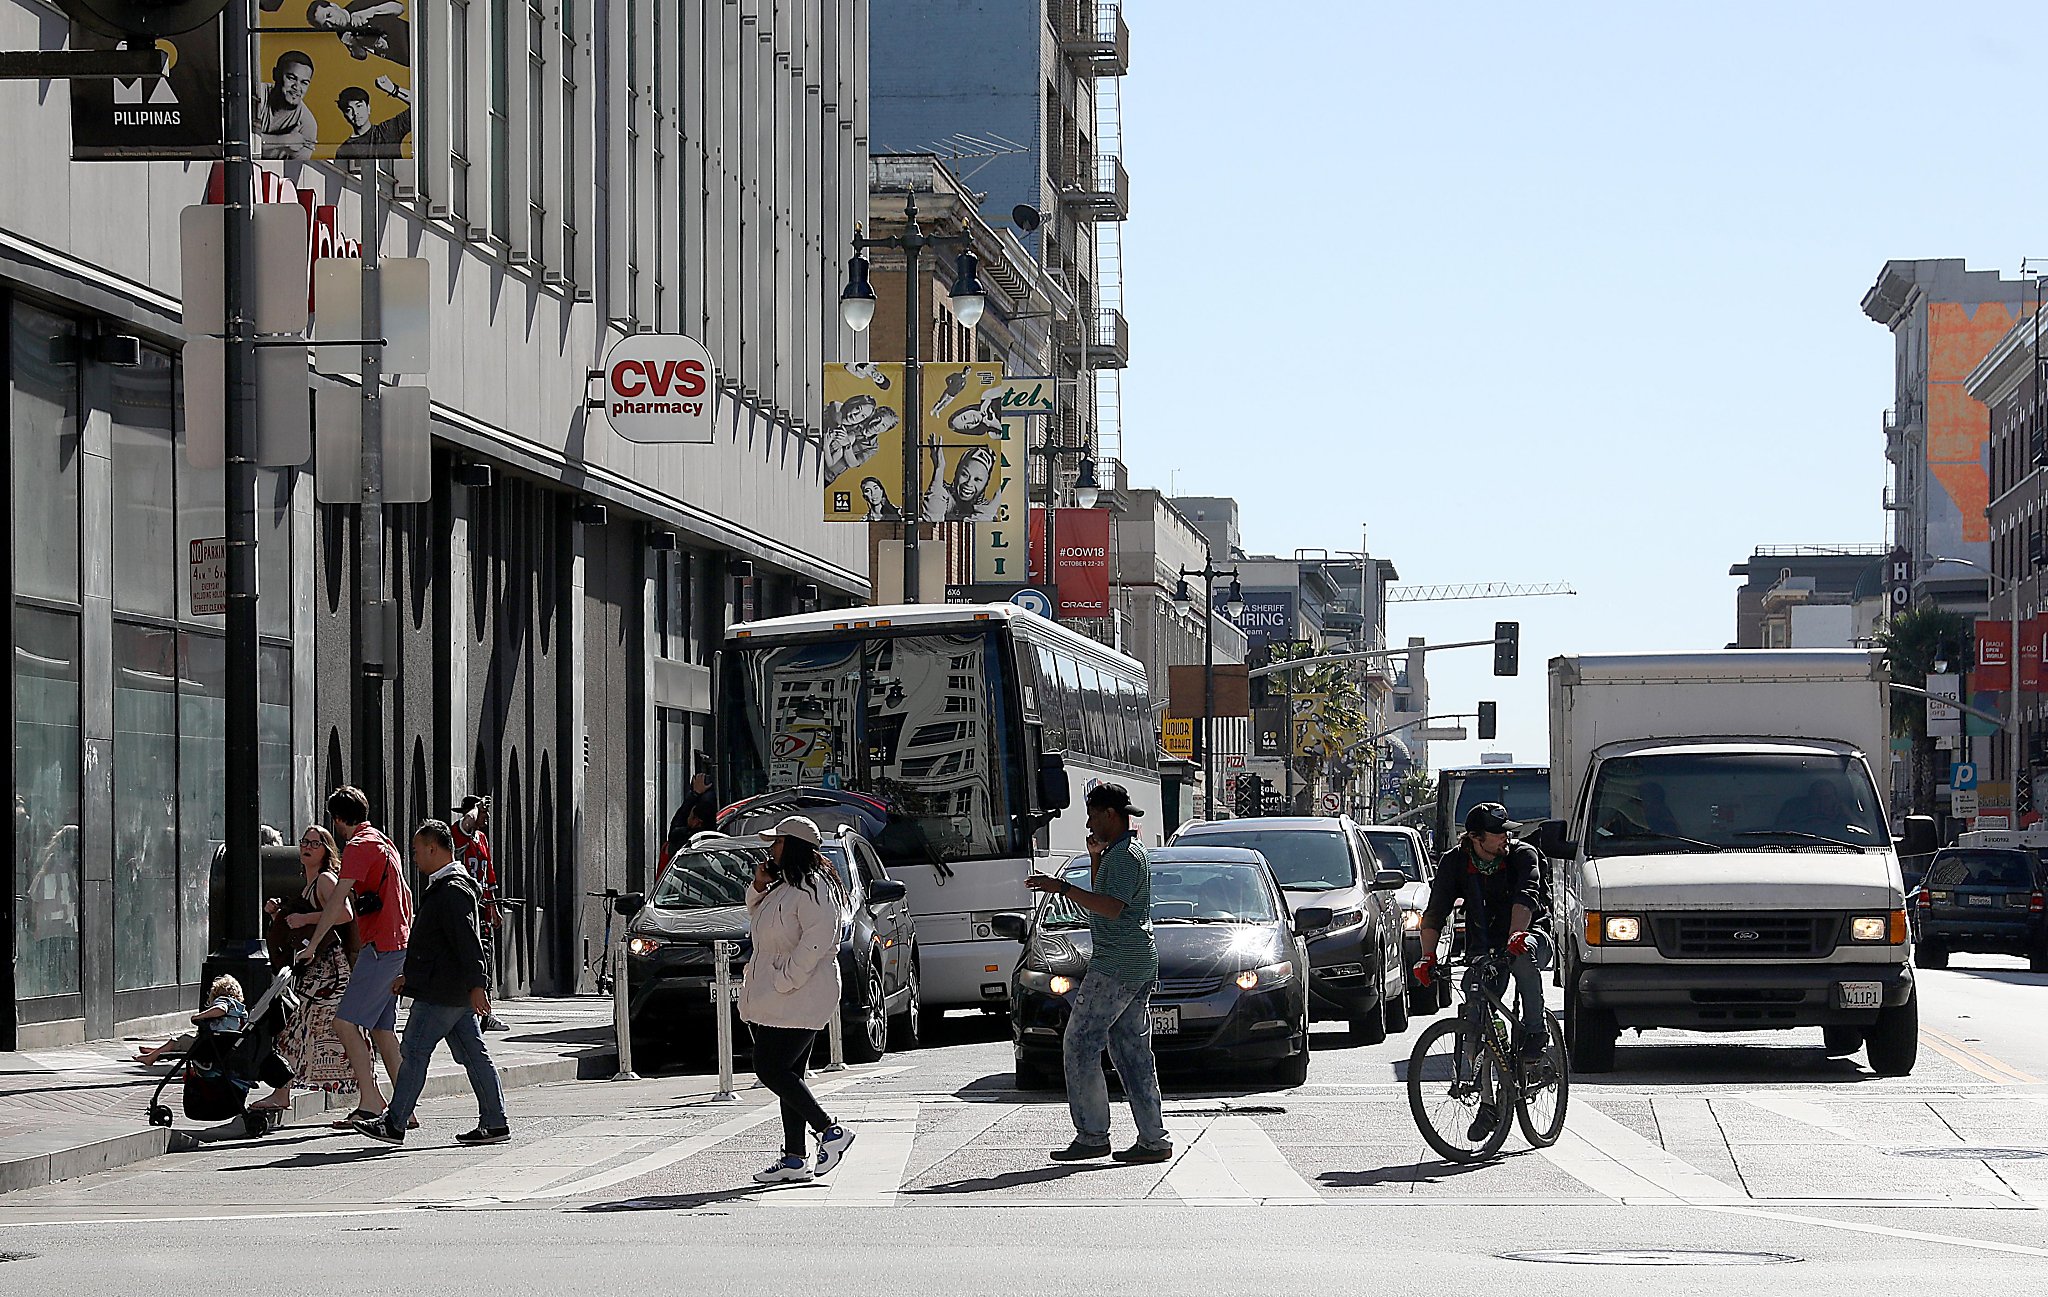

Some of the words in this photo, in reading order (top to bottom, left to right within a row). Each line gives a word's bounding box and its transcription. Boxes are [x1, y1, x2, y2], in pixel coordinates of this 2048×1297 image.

[114, 111, 181, 125] PILIPINAS
[611, 360, 706, 397] CVS
[1001, 383, 1040, 407] tel
[612, 400, 703, 418] pharmacy
[192, 543, 202, 563] NO
[204, 545, 225, 560] PARKIN
[1059, 547, 1105, 557] #OOW18
[947, 588, 961, 596] 6X6
[1061, 601, 1103, 609] ORACLE
[1251, 604, 1285, 612] SHERIFF
[1242, 627, 1263, 635] Team
[1165, 722, 1190, 736] LIQUOR
[1169, 738, 1191, 750] MARKET
[1226, 756, 1246, 768] PIZZA
[1846, 991, 1879, 1005] 411P1
